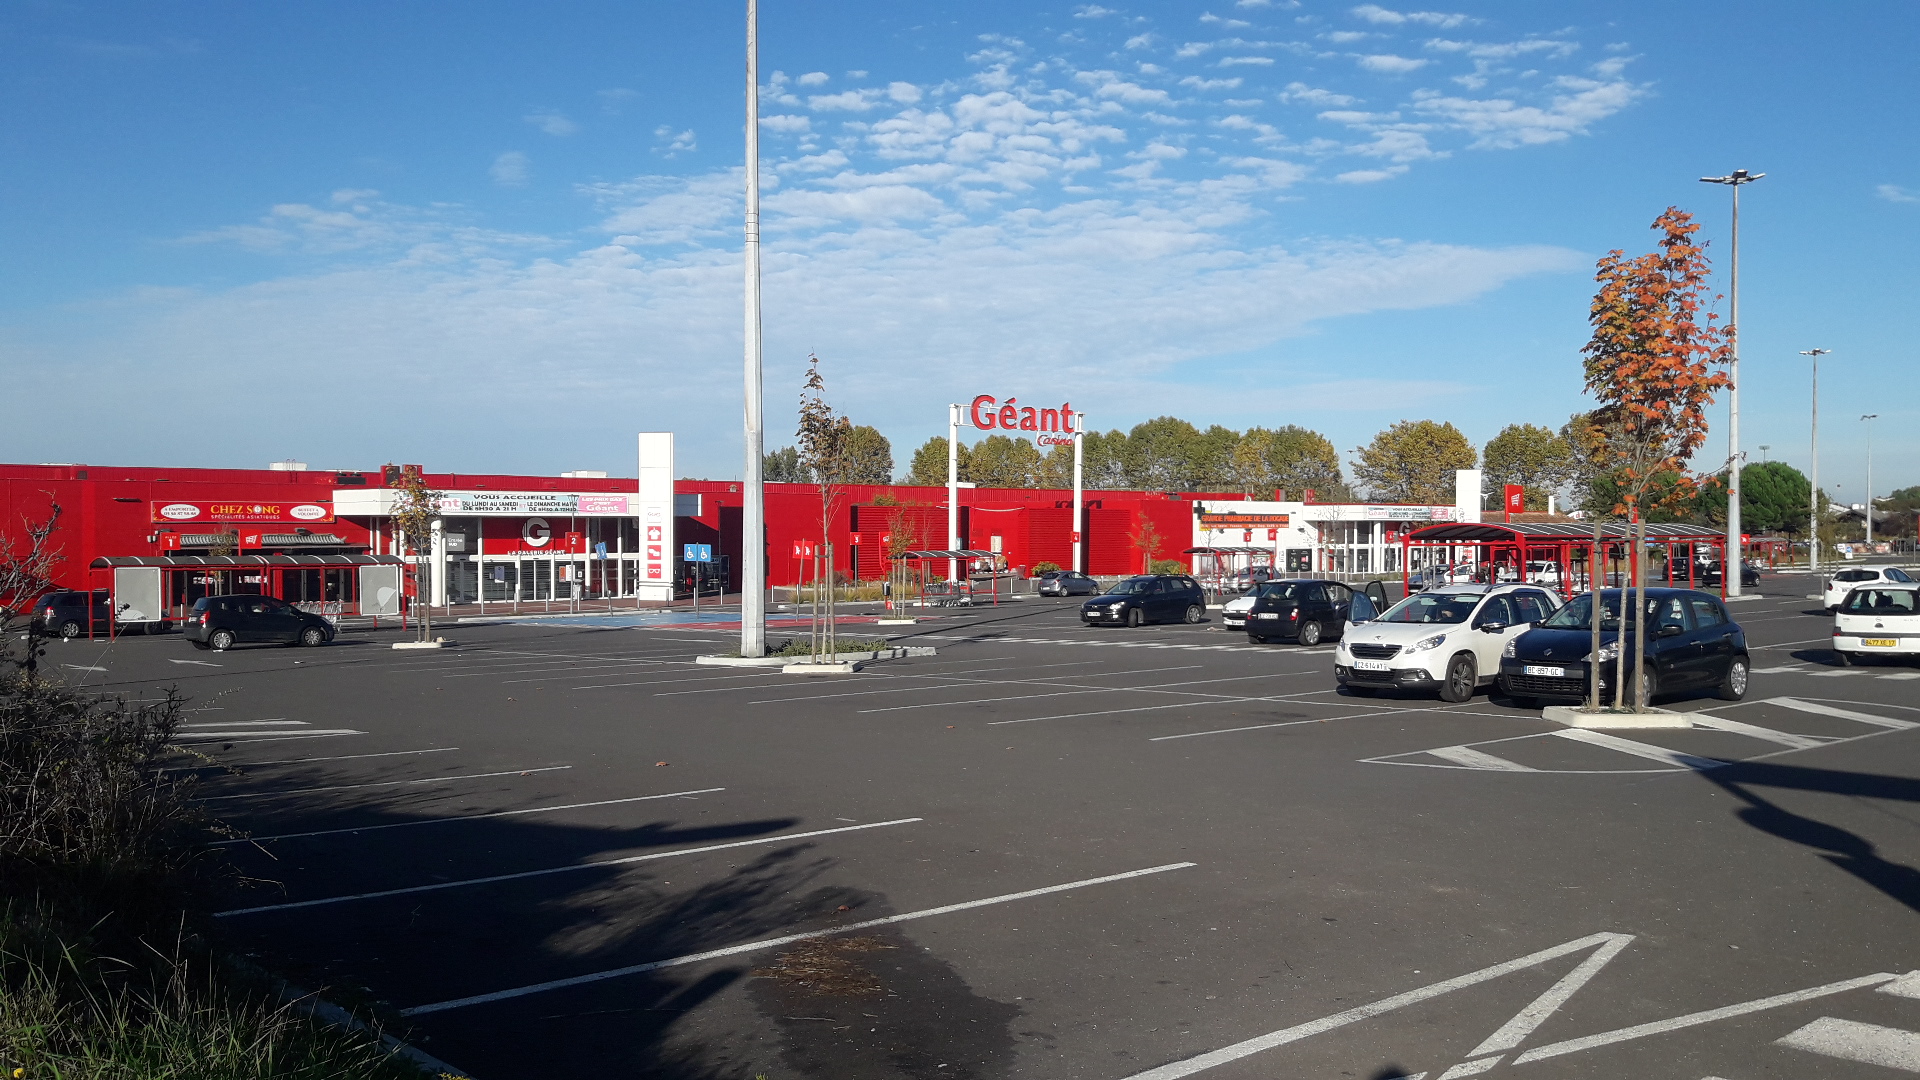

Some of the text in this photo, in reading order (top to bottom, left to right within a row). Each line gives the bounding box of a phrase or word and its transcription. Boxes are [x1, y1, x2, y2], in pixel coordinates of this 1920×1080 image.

[970, 394, 1074, 434] Géant
[1037, 435, 1073, 447] Casino
[210, 504, 244, 515] CHEZ
[246, 504, 281, 515] SONG
[522, 517, 552, 548] G
[168, 539, 173, 547] 1
[854, 536, 859, 544] 3
